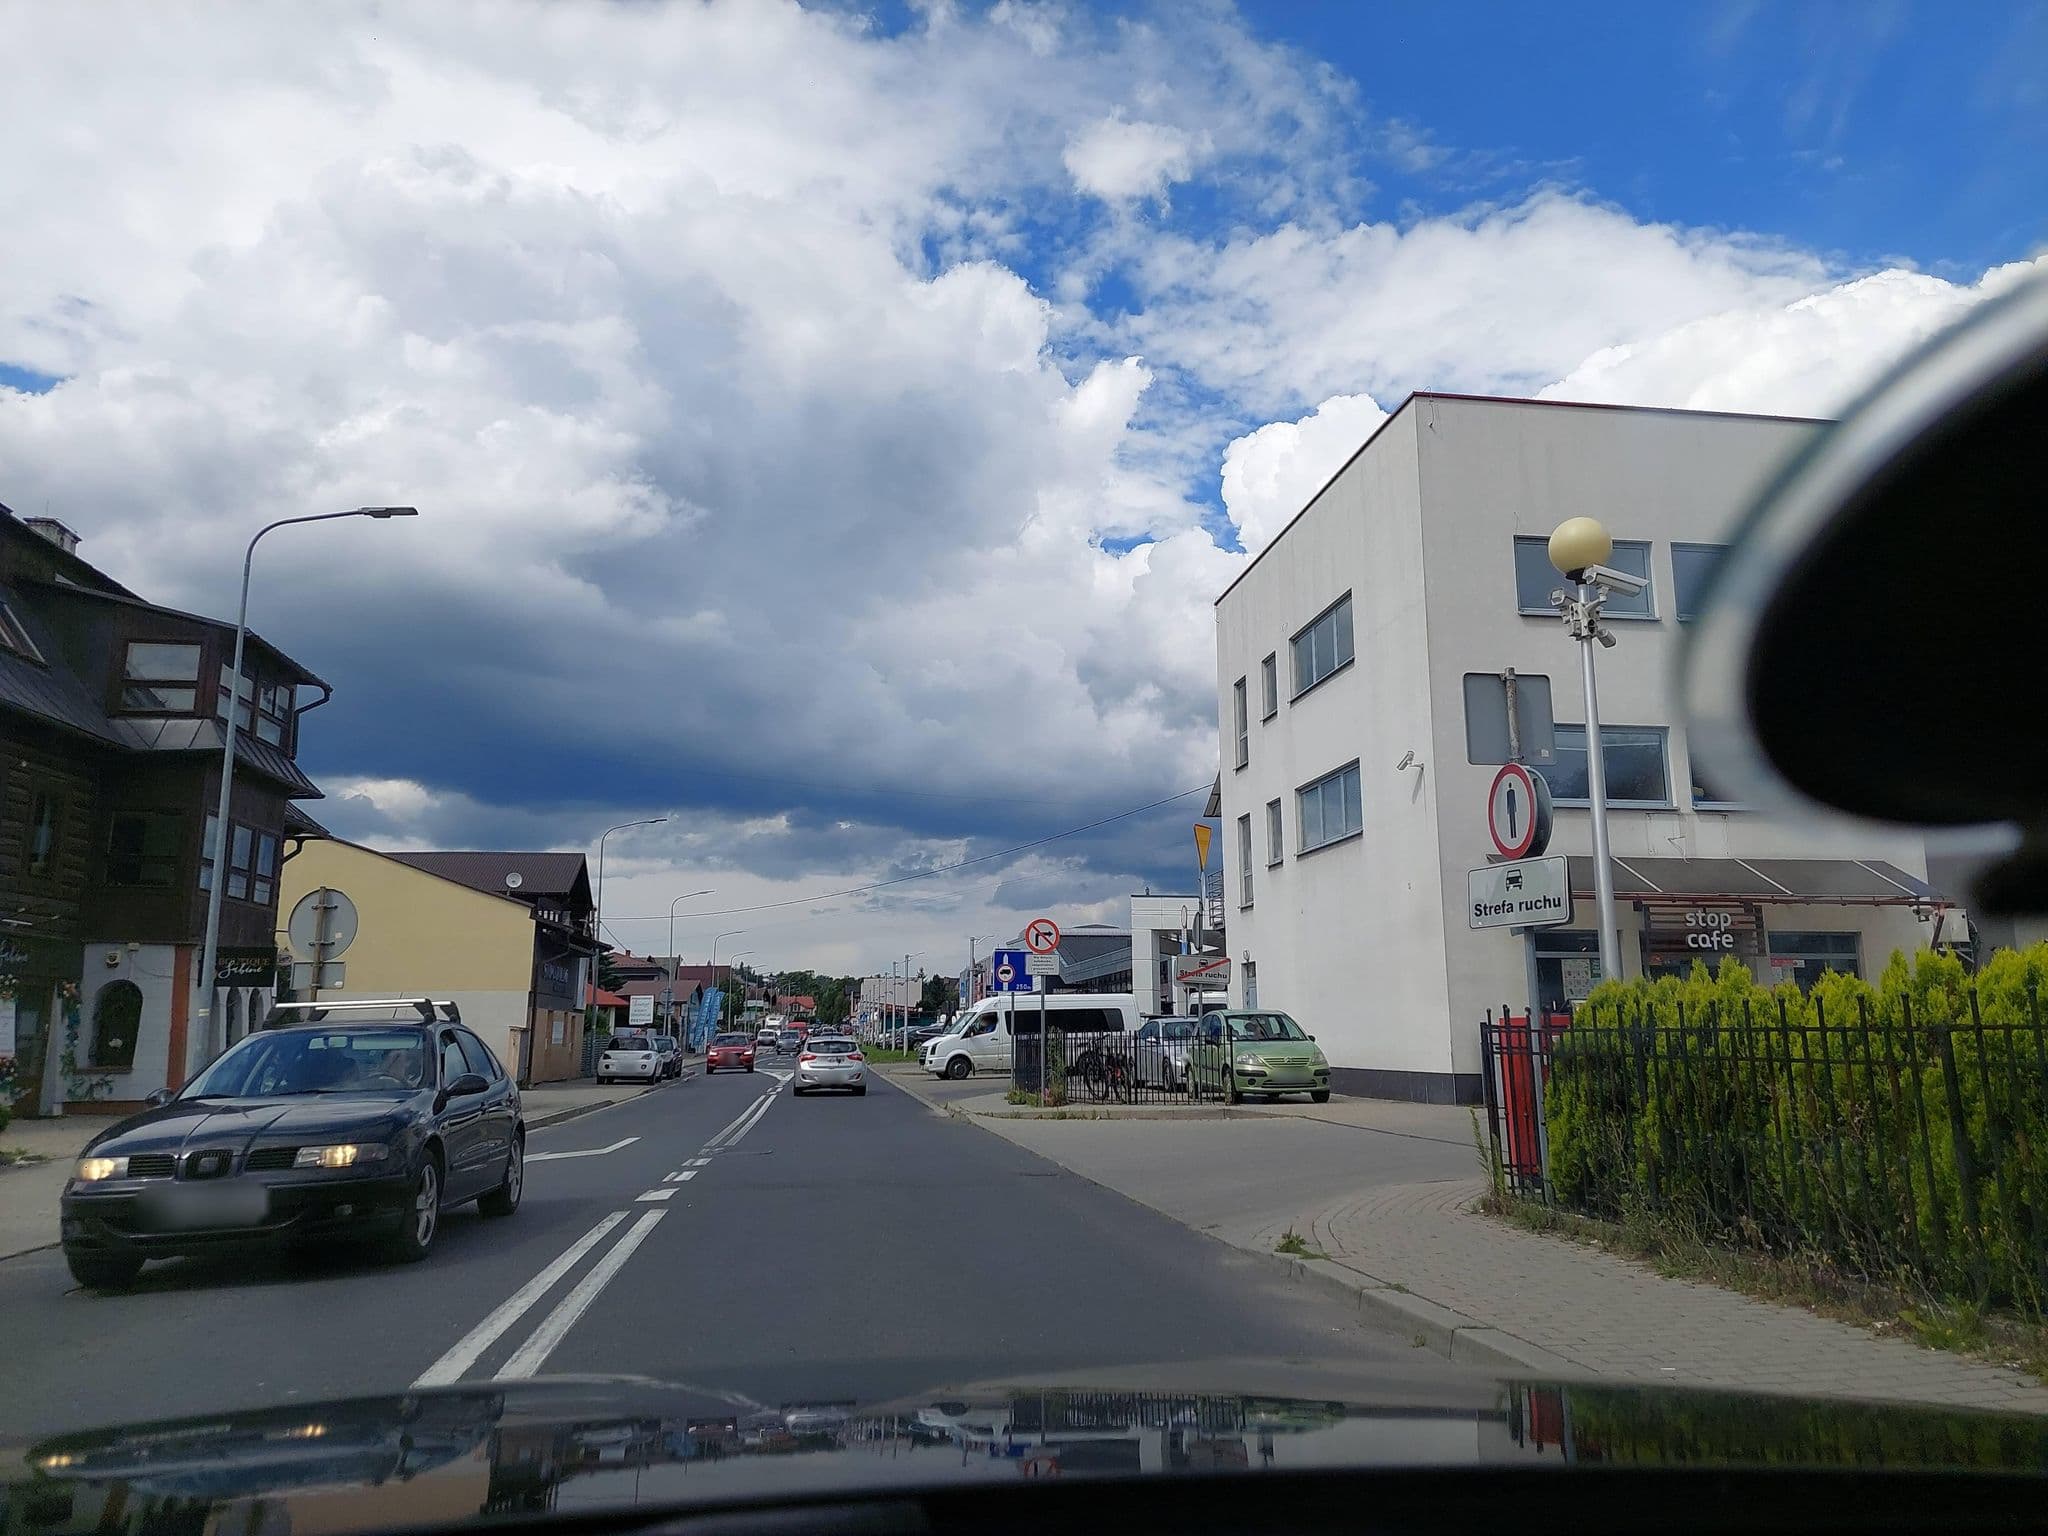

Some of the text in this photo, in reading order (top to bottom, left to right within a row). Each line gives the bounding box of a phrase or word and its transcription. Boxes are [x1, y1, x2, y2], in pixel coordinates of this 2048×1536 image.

[1474, 895, 1561, 917] Strefa ruchu
[1686, 908, 1732, 931] stop
[1687, 932, 1734, 951] cafe
[1205, 970, 1228, 979] ruchu
